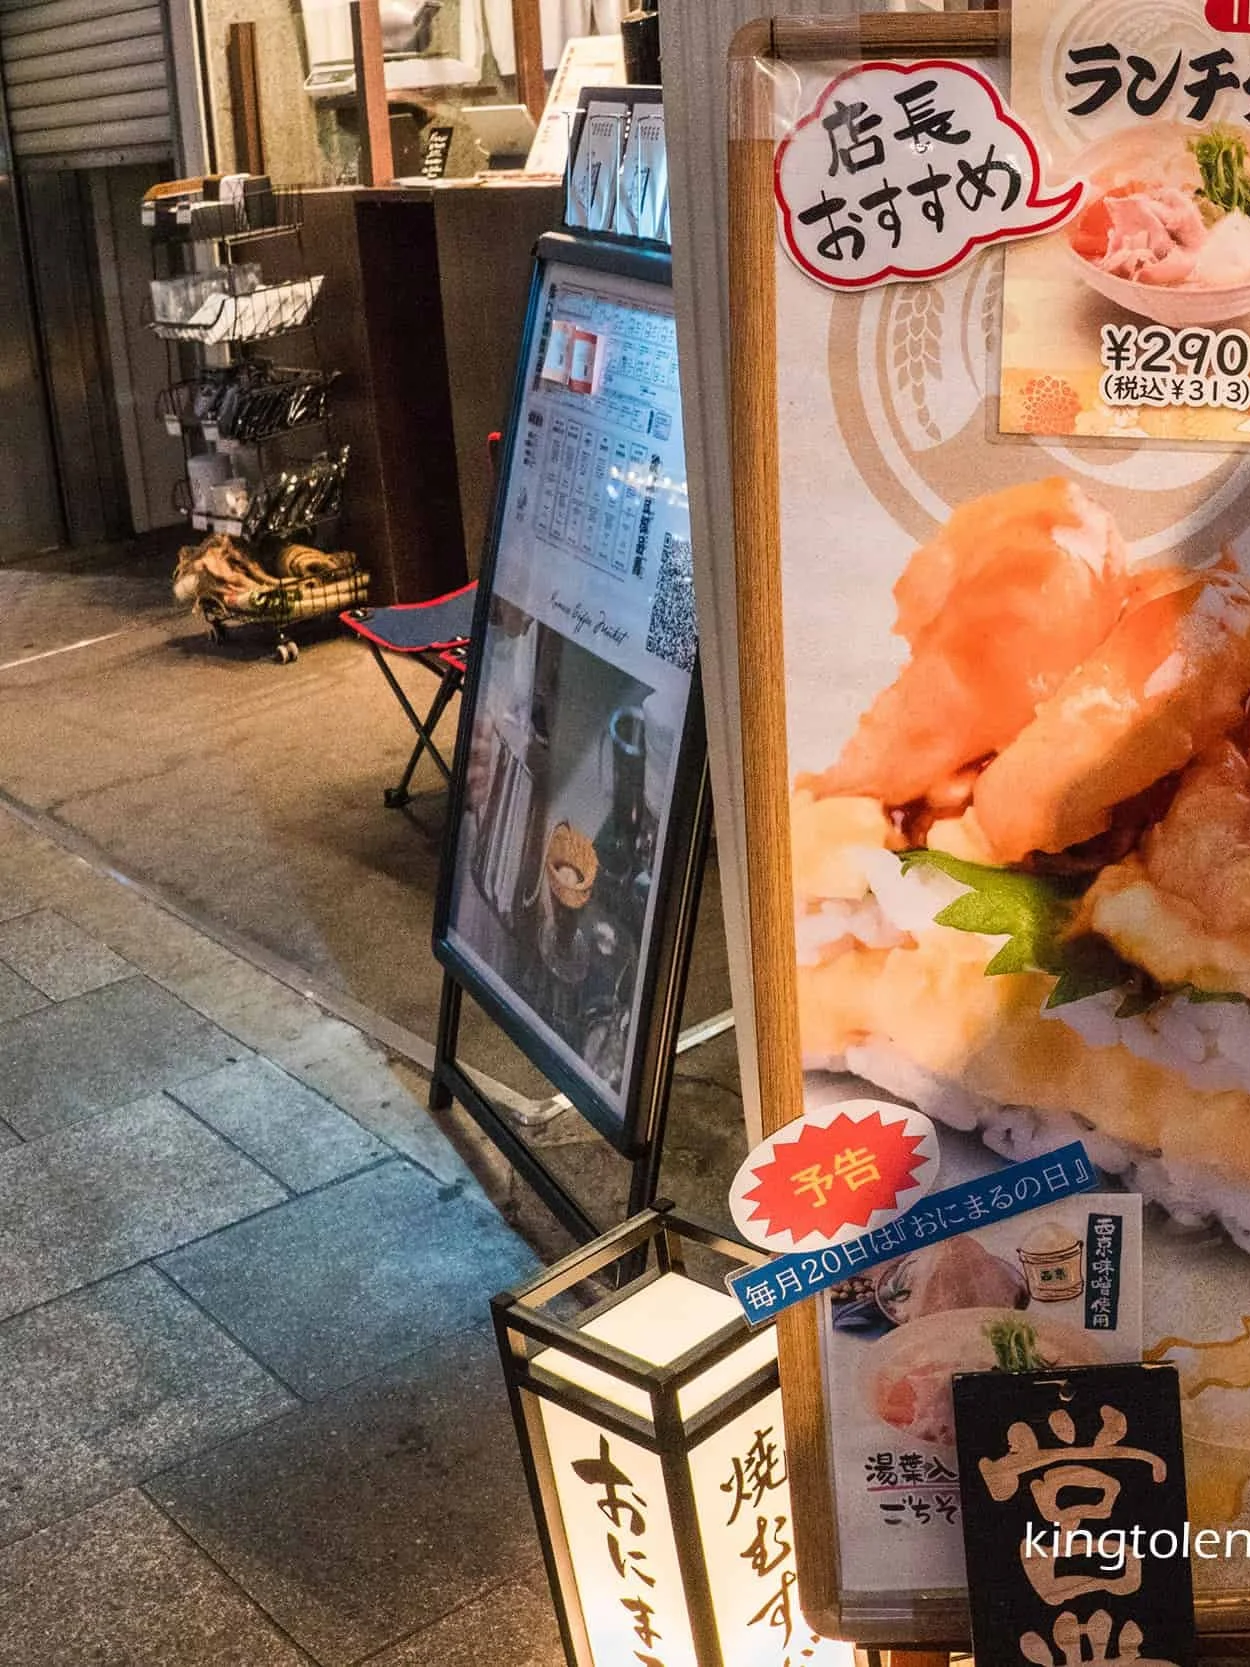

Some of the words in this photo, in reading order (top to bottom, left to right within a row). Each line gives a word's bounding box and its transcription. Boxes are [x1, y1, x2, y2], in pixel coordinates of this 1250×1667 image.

[821, 80, 971, 178] 店長
[798, 144, 1022, 262] おすすめ
[1105, 329, 1249, 376] ¥290
[789, 1145, 882, 1210] 予告
[1090, 1218, 1116, 1328] 西京味噌使用
[571, 1433, 665, 1667] おにま
[719, 1426, 821, 1667] 焼むす
